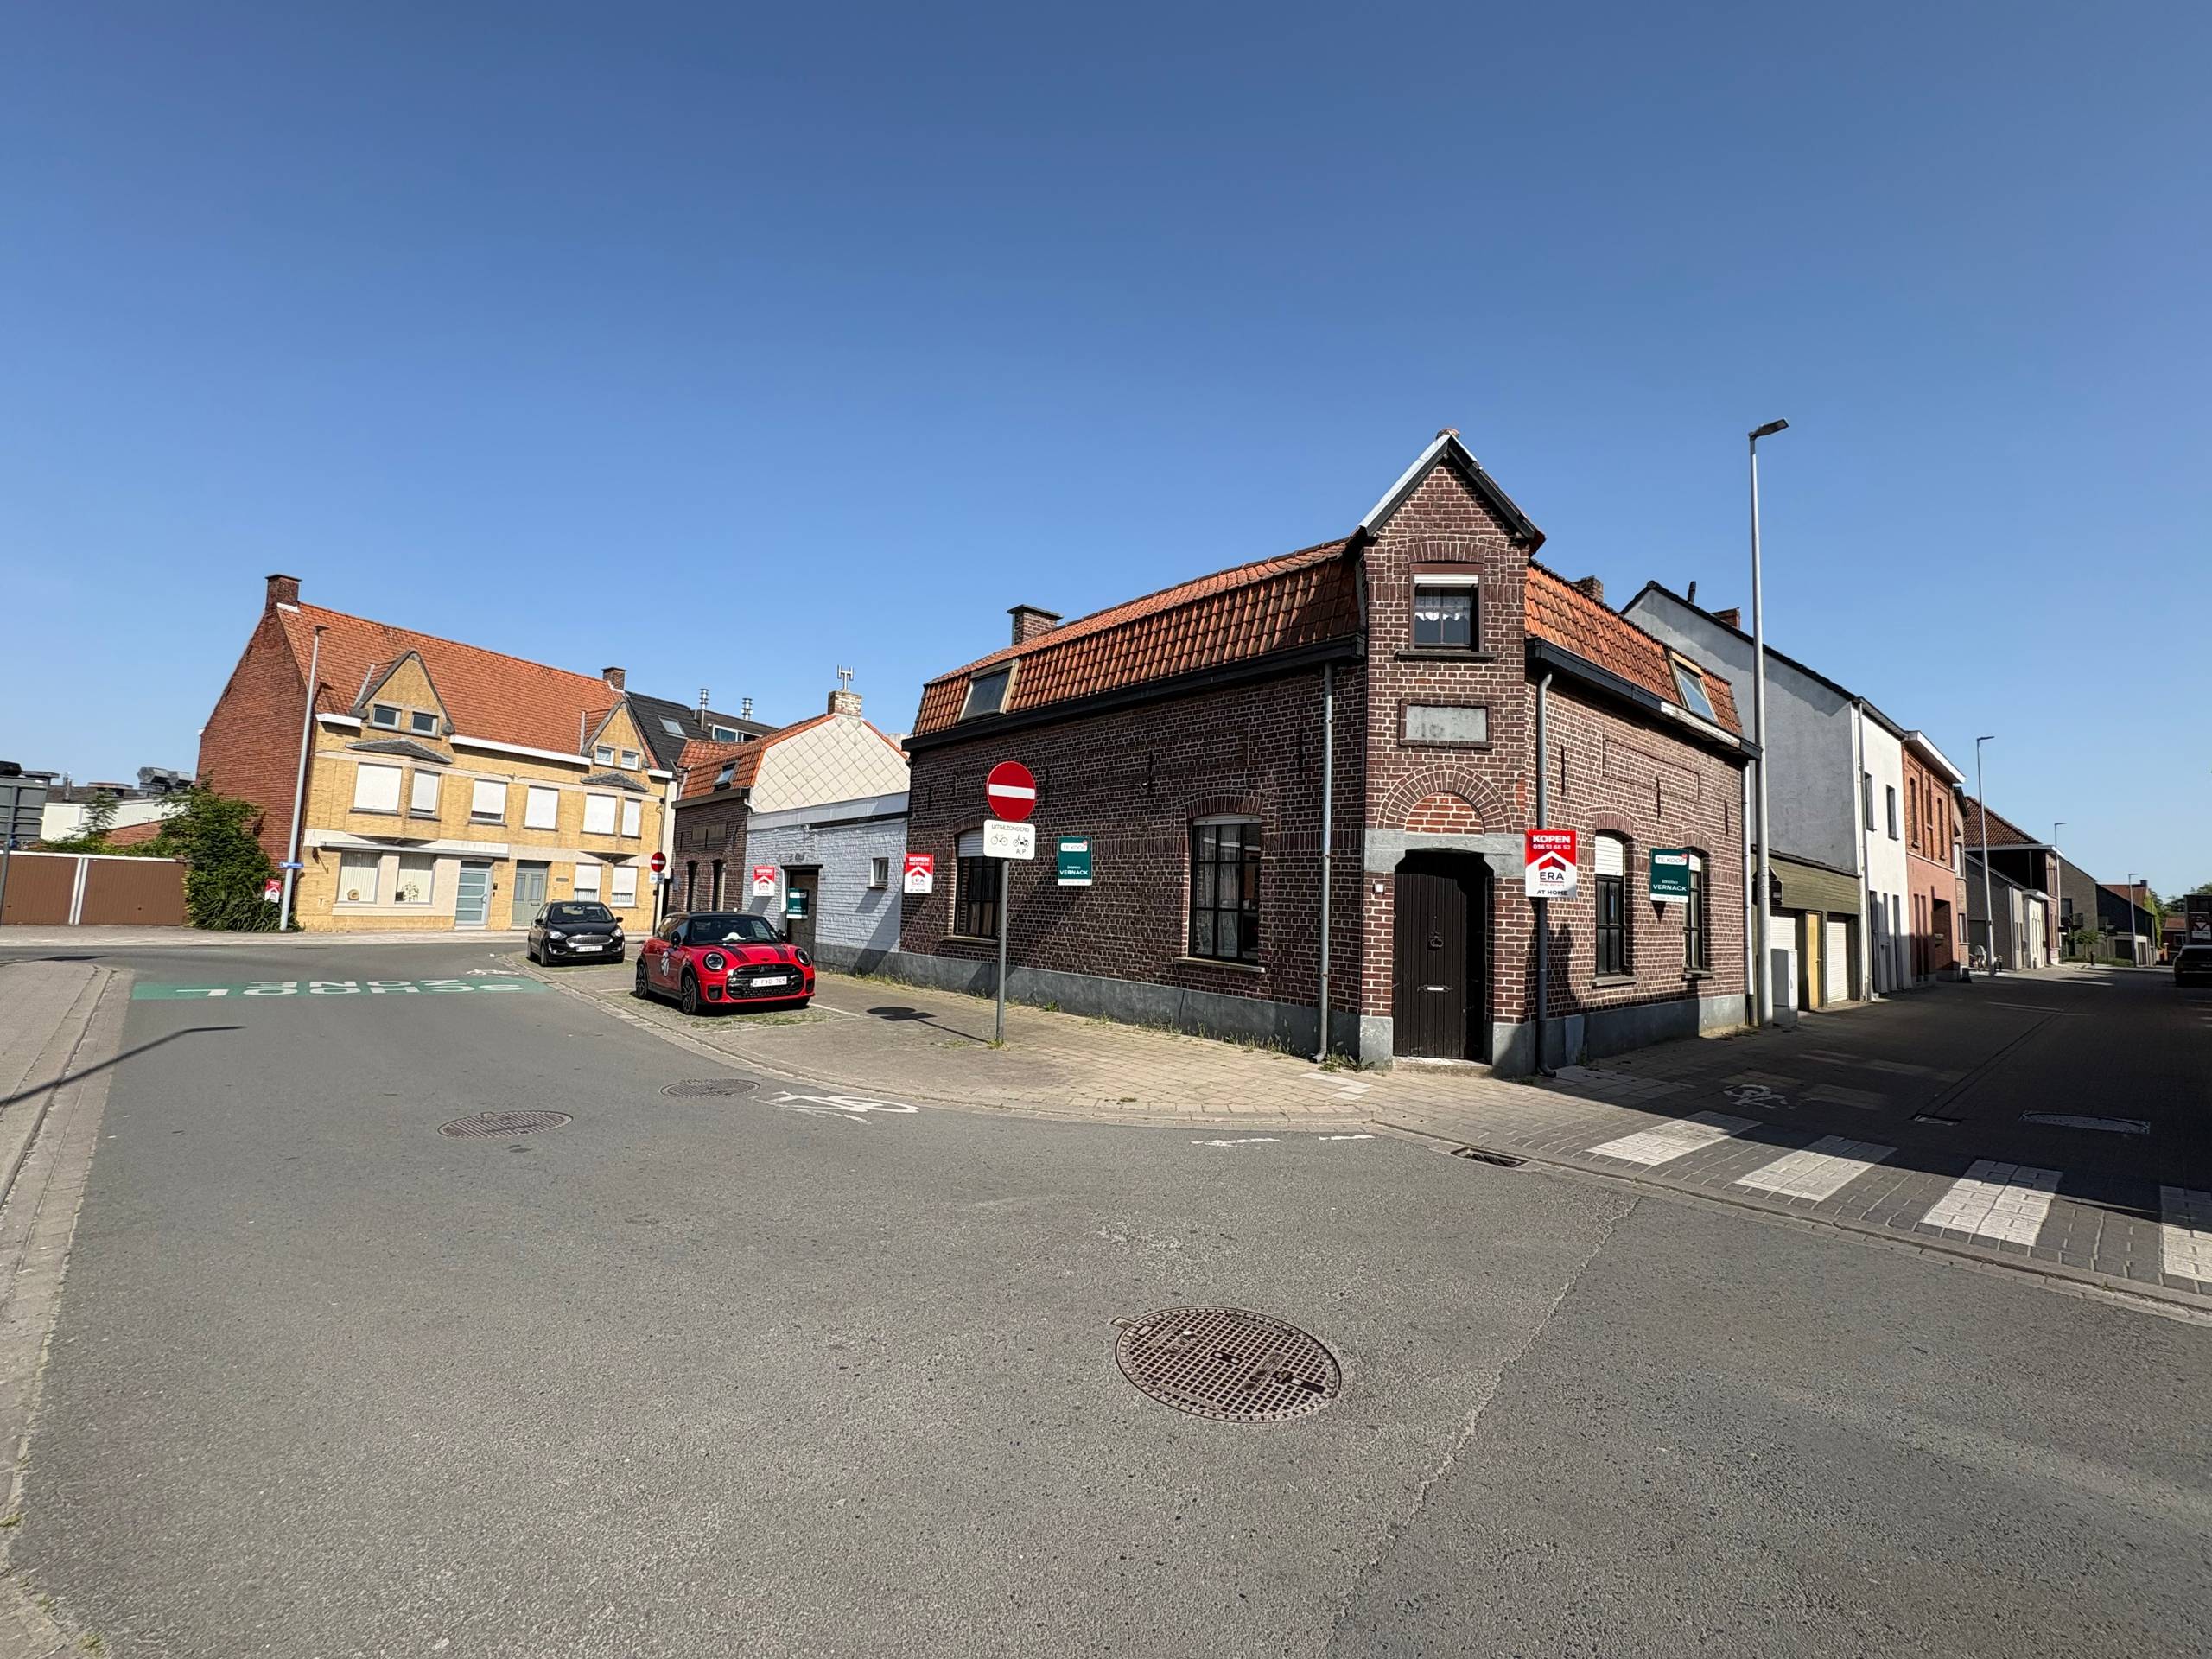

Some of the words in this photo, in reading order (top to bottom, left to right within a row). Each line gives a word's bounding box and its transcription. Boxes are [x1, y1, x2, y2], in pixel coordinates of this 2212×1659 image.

[1532, 835, 1571, 843] KOPEN
[1539, 871, 1565, 880] ERA
[246, 979, 467, 988] ZONE
[175, 983, 524, 996] SCHOOL
